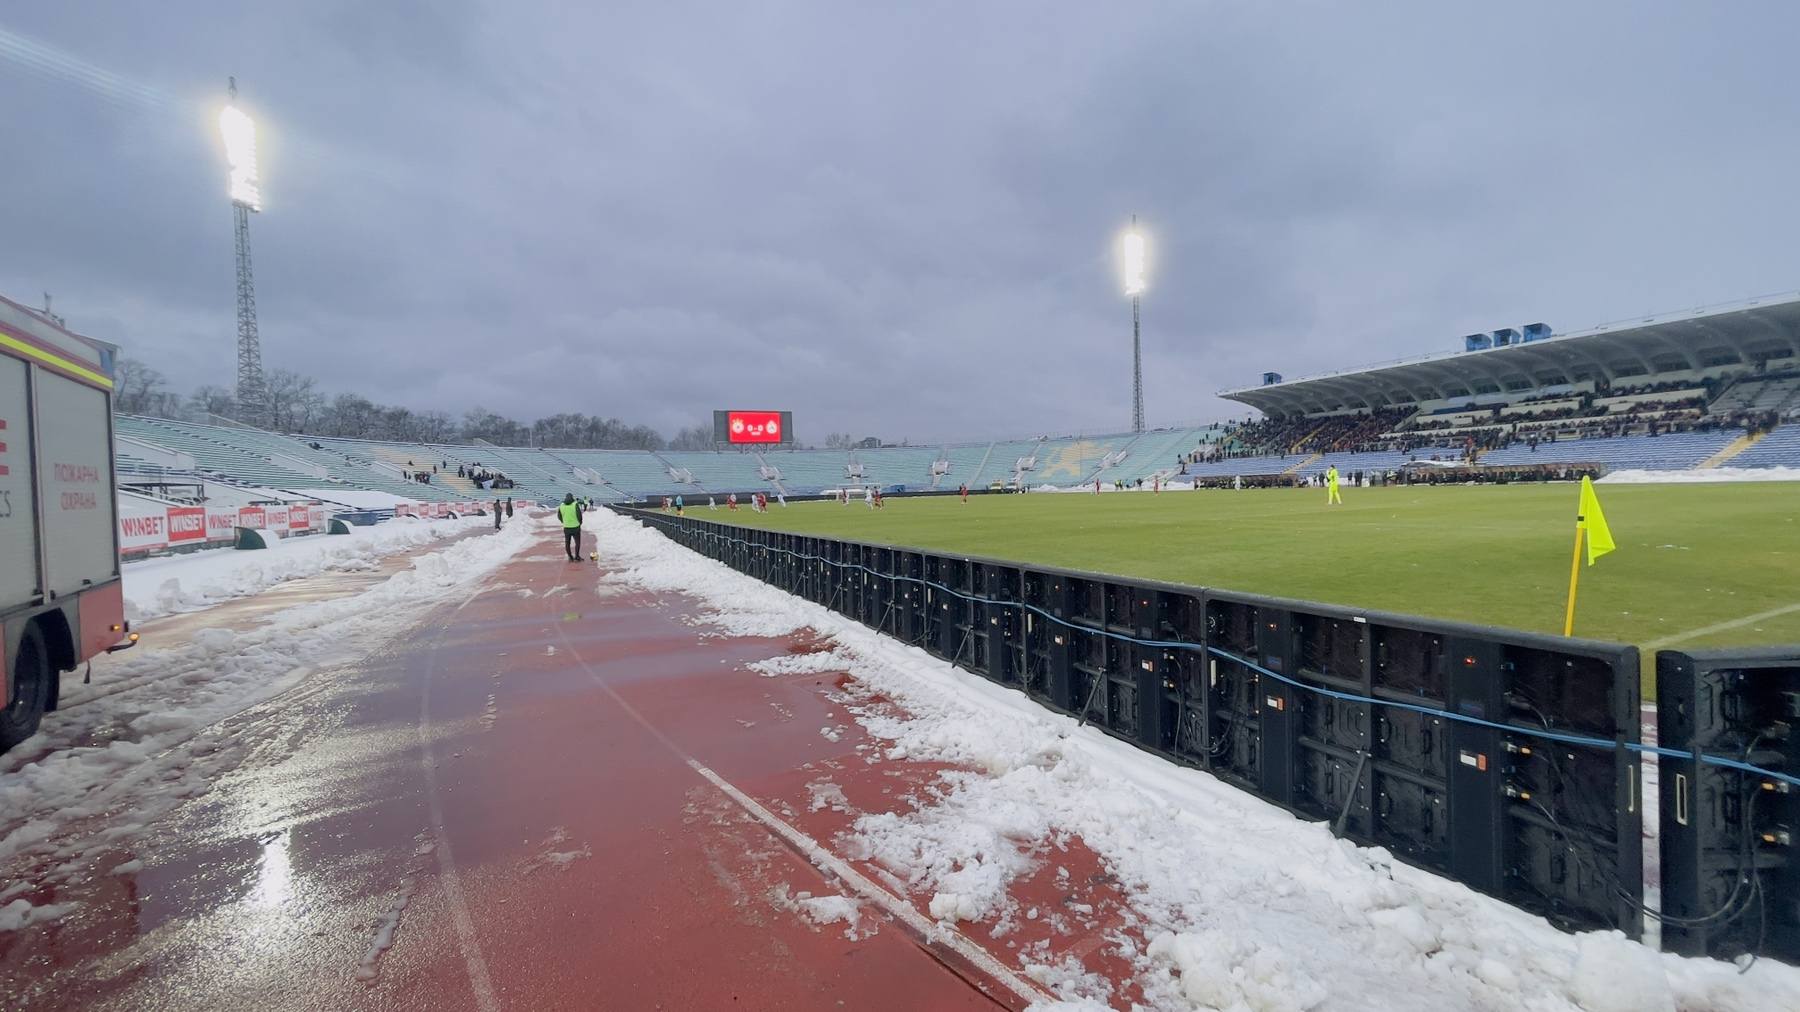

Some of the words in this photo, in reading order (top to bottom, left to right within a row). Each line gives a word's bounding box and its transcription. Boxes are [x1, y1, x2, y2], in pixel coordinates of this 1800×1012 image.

[169, 514, 203, 533] WINBET
[208, 515, 236, 529] WINBET
[240, 513, 265, 528] WINBET
[267, 512, 287, 524] WINBET
[121, 516, 164, 537] WINBET
